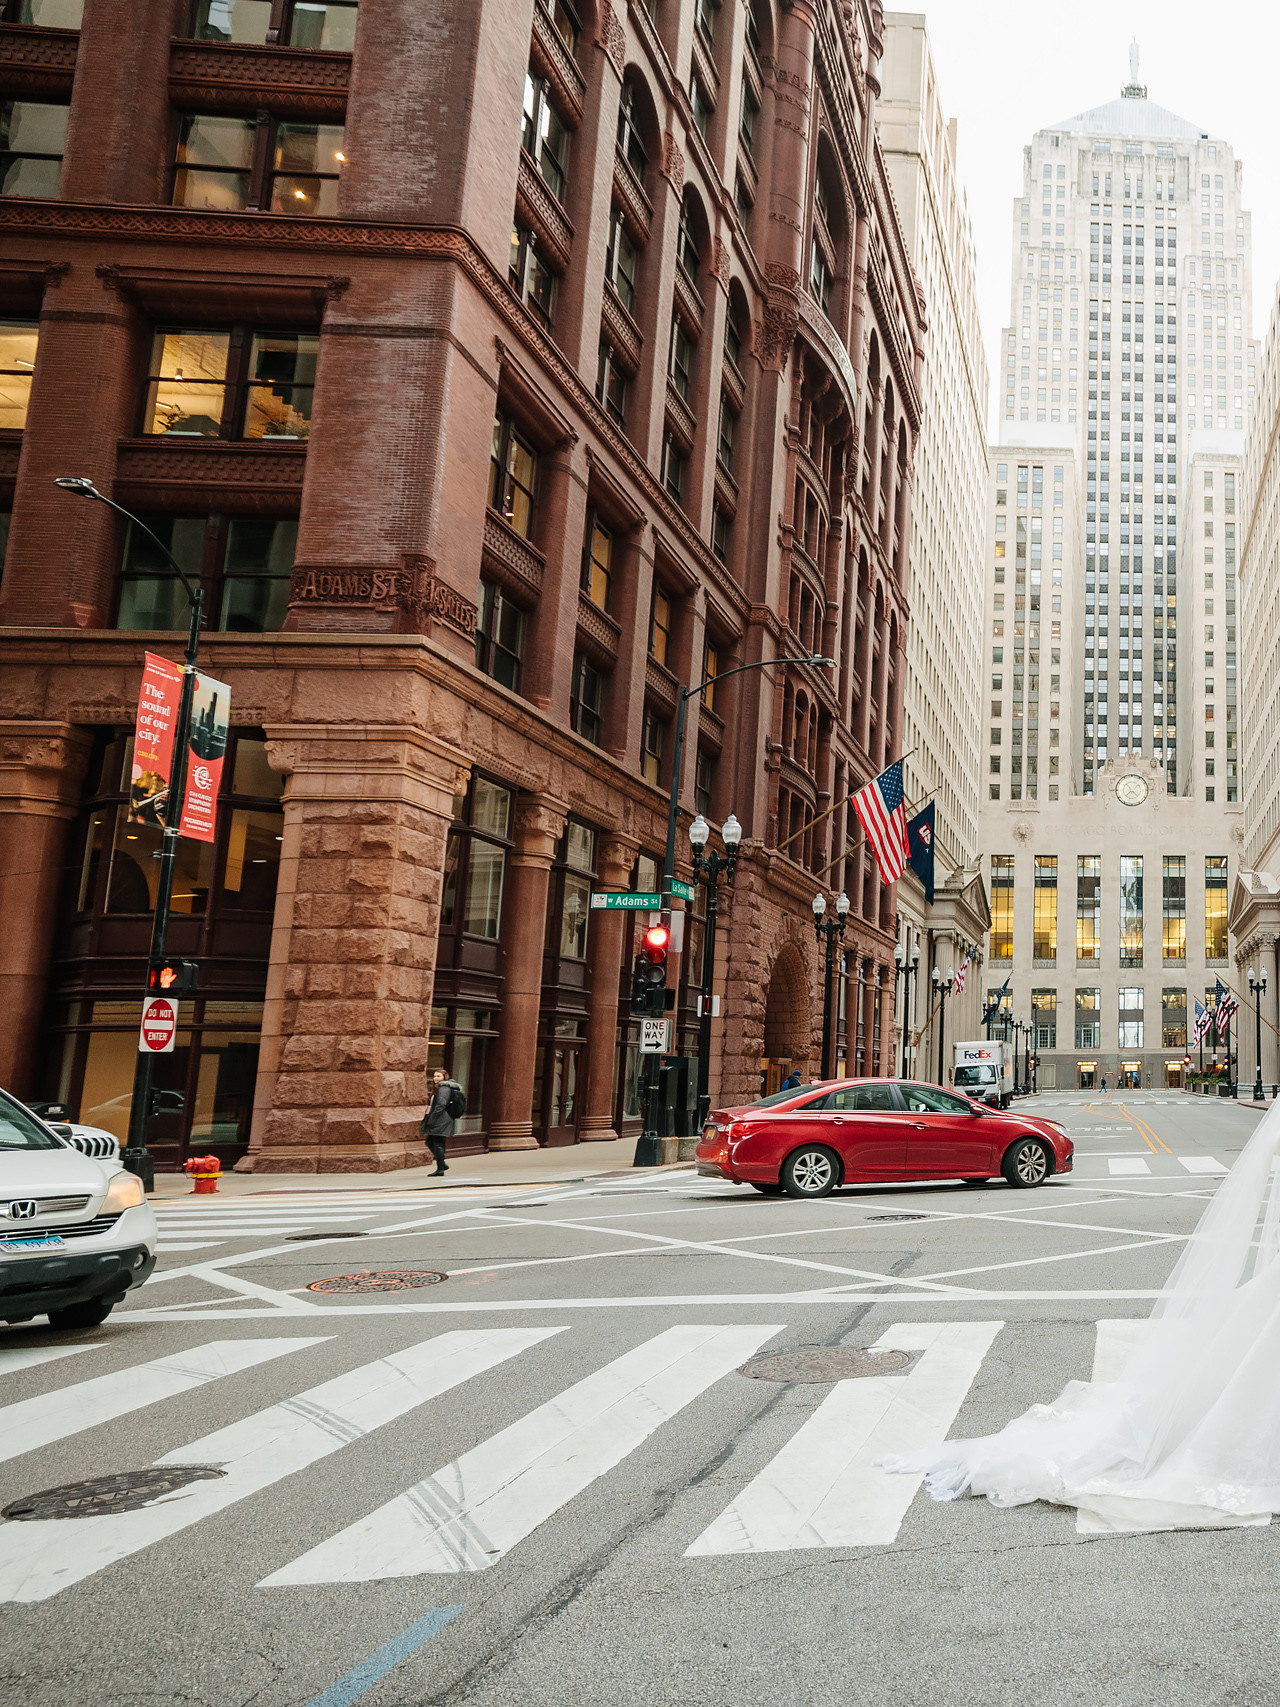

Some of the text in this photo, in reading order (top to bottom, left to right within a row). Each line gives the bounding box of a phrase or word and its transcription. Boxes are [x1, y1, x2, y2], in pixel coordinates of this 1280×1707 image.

[301, 571, 370, 598] ADAMS
[144, 683, 165, 699] The
[141, 700, 171, 717] sound
[140, 715, 169, 731] of our
[138, 728, 161, 745] city.
[1044, 826, 1220, 836] CHICAGO BOARD OF TRADE
[615, 896, 649, 906] Adams
[148, 1008, 172, 1018] DO NOT
[645, 1021, 665, 1030] ONE
[148, 1031, 169, 1041] ENTER
[644, 1031, 665, 1039] WAY
[964, 1050, 992, 1059] FedEx
